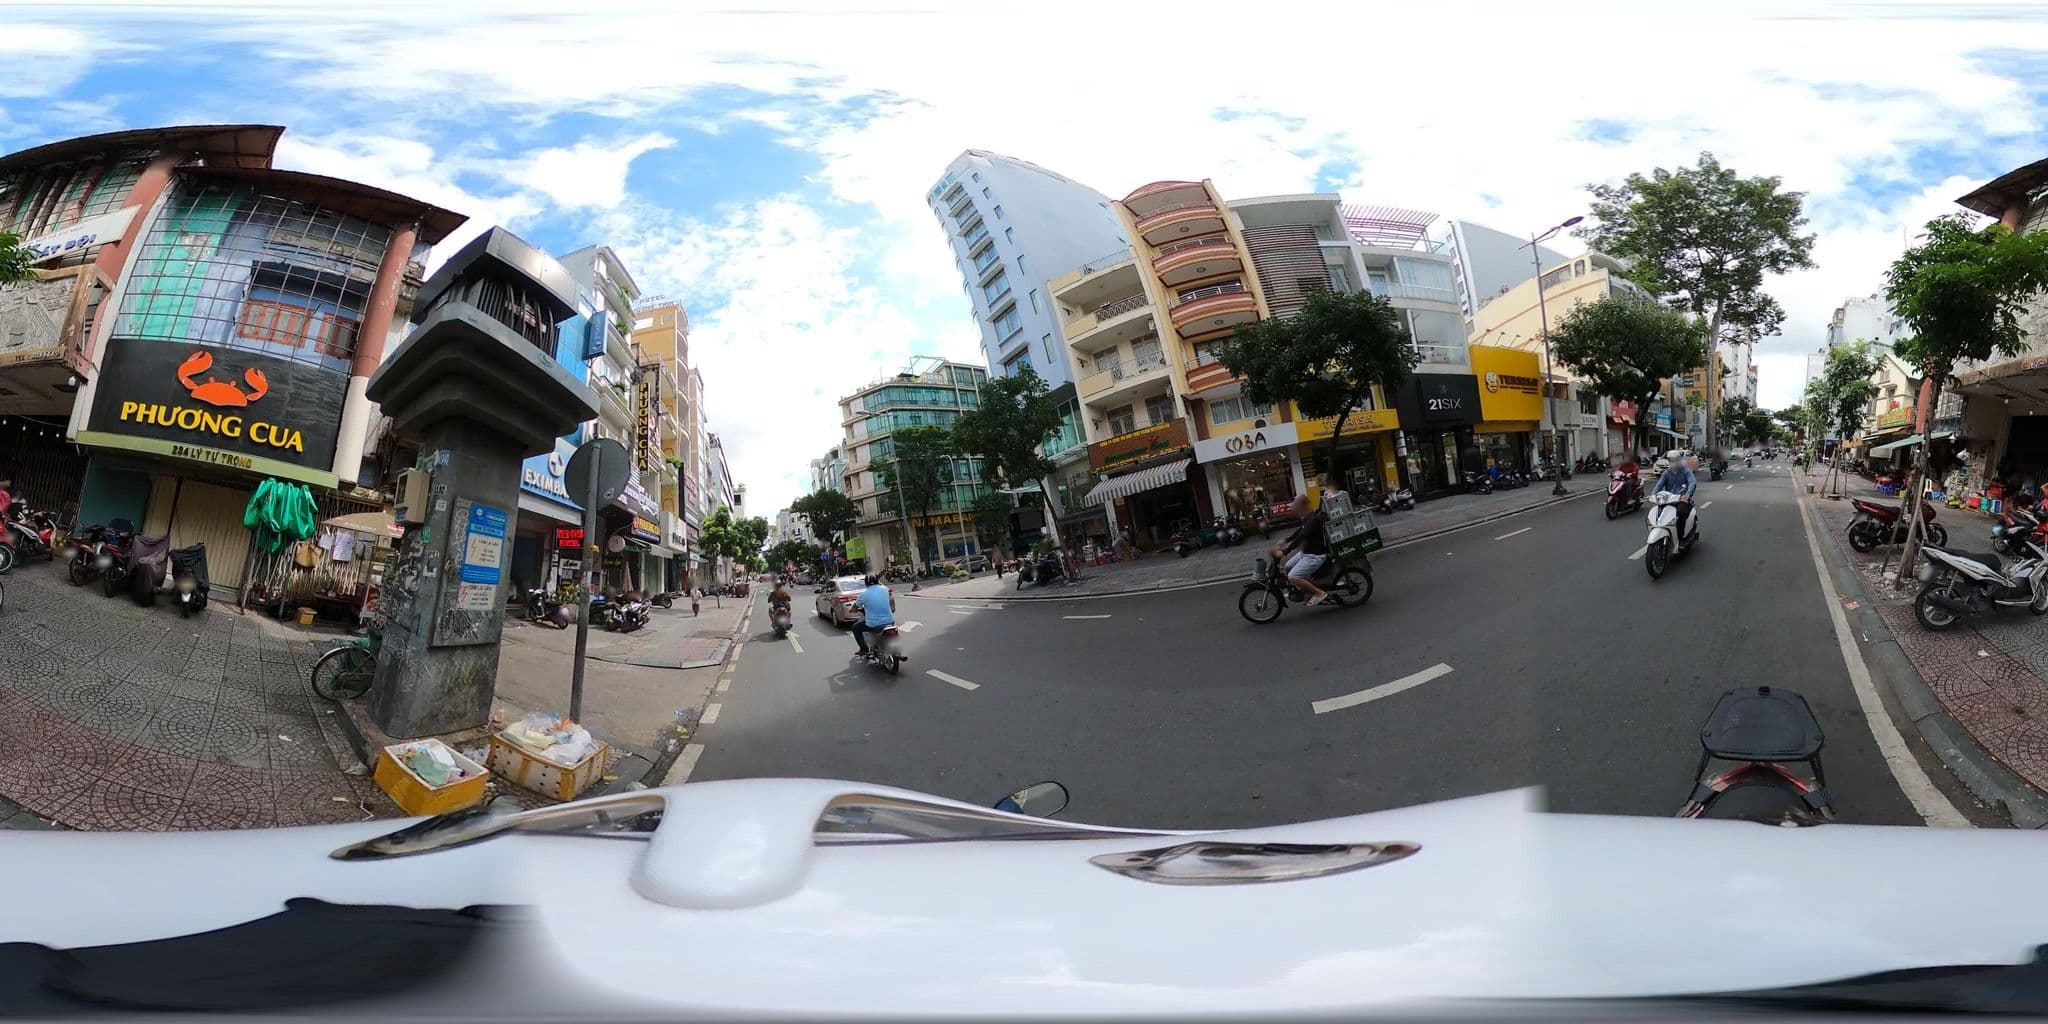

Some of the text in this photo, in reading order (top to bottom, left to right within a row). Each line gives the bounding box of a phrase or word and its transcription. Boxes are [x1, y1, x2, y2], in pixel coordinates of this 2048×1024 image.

[1428, 398, 1462, 410] 21SIX
[120, 401, 304, 453] PHƯƠNG CUA
[1322, 415, 1375, 429] TERISA
[171, 445, 189, 457] 234
[639, 439, 648, 469] CUA
